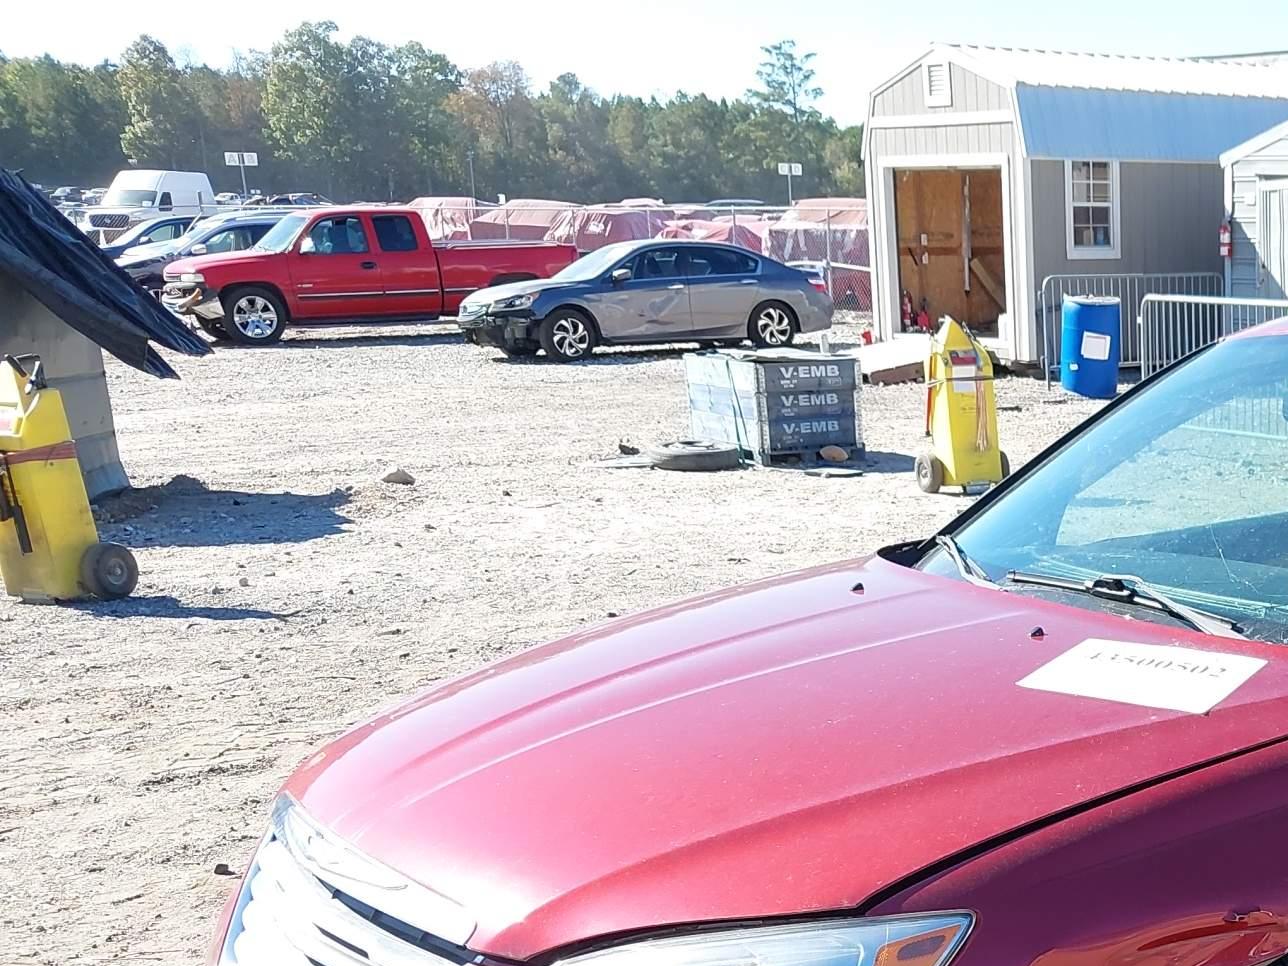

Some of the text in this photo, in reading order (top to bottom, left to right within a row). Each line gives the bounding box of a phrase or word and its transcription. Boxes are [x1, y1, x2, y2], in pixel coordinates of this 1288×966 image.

[779, 364, 840, 379] V-EMB
[780, 393, 839, 406] V-EMB
[782, 420, 840, 434] V-EMB
